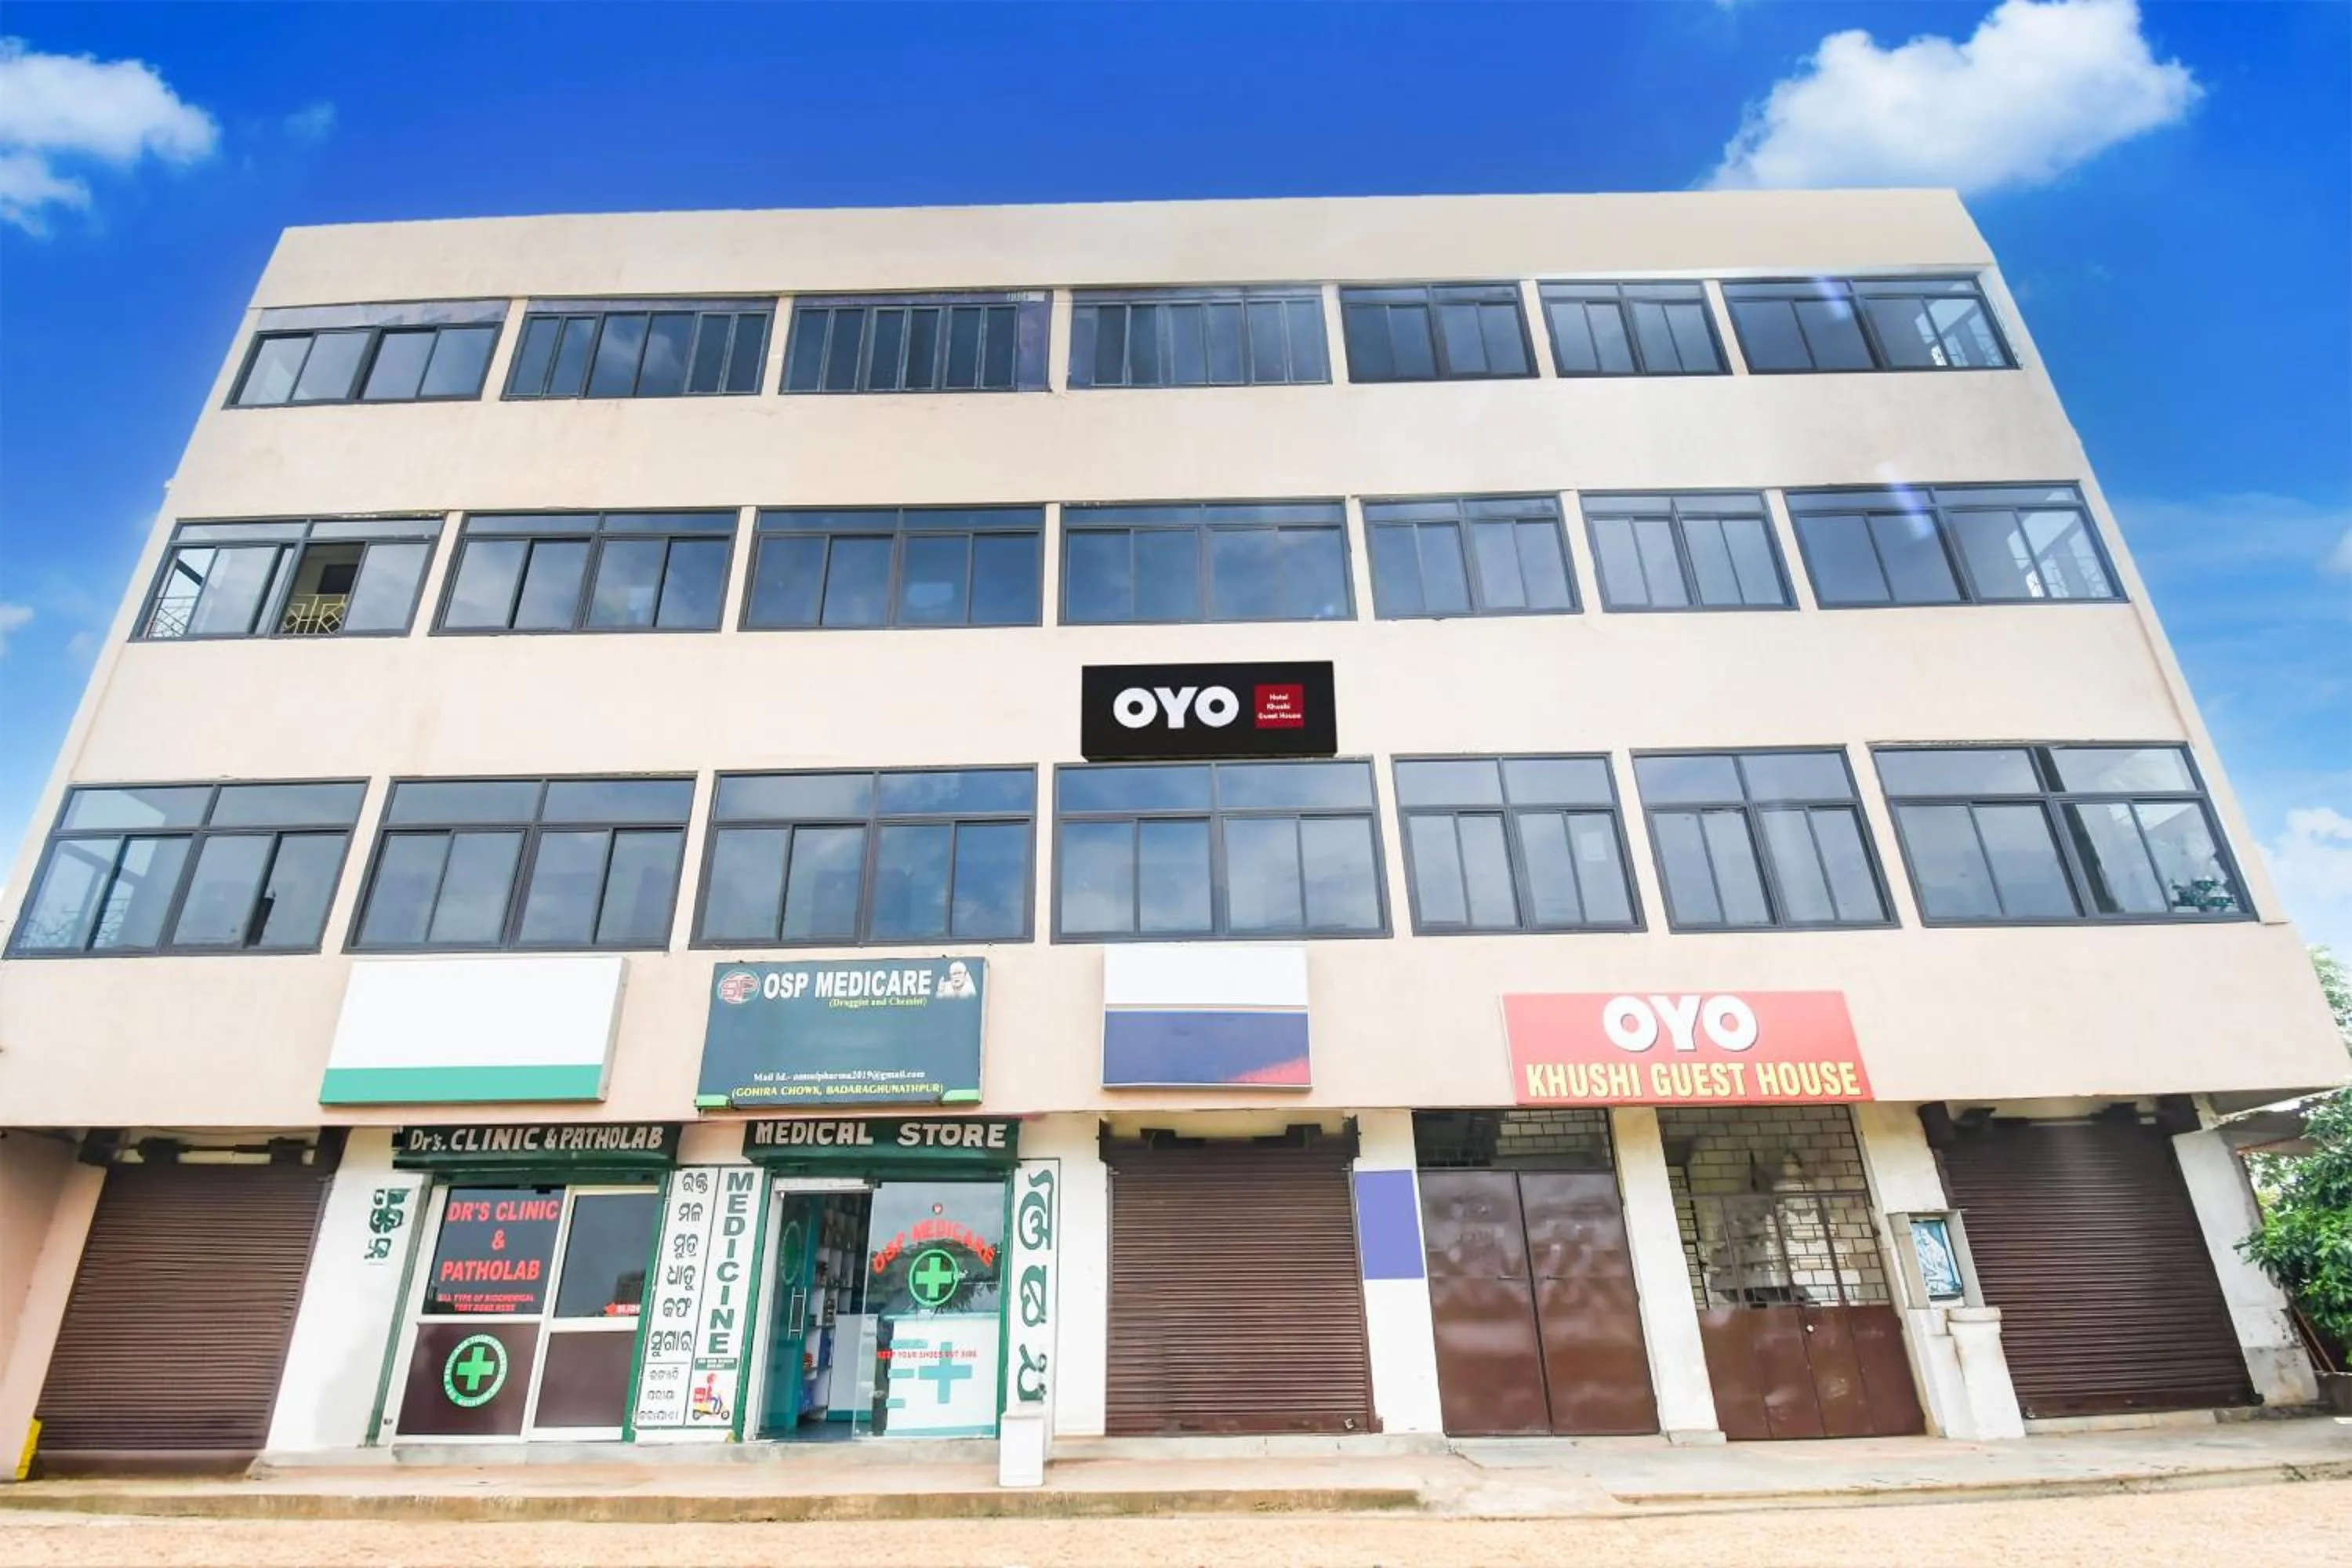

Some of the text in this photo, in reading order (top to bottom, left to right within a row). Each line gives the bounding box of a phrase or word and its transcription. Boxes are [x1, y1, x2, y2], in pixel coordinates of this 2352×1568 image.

[1113, 686, 1240, 729] OYO
[763, 970, 932, 999] OSP MEDICARE
[871, 997, 886, 1006] and
[1603, 995, 1759, 1052] OYO
[1526, 1062, 1862, 1098] KHUSHI GUEST HOUSE
[450, 1127, 540, 1150] CLINIC
[755, 1122, 1007, 1148] MEDICAL STORE
[446, 1200, 559, 1222] DR'S CLINIC
[491, 1229, 506, 1250] &
[911, 1218, 996, 1269] MEDICARE
[440, 1259, 541, 1282] PATHOLAB
[707, 1171, 755, 1355] MEDICINE
